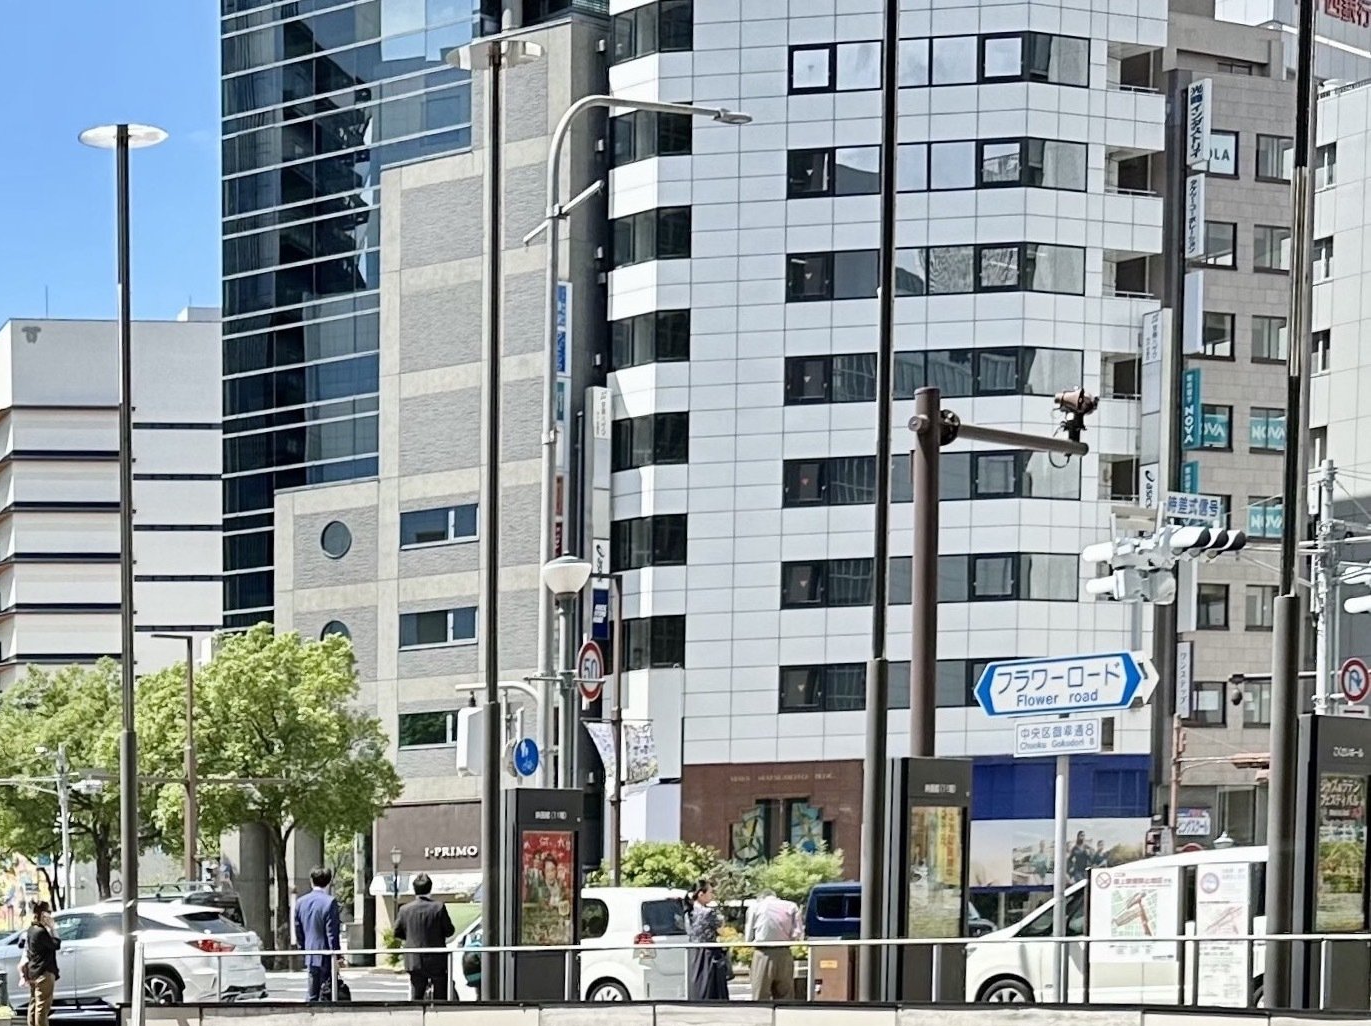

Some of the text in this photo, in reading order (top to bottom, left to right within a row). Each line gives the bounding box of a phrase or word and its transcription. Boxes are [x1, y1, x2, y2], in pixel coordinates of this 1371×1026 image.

[1183, 404, 1195, 444] NOVA
[583, 658, 598, 680] 50
[996, 661, 1121, 695] フラワーロード
[1016, 689, 1099, 708] Flower road
